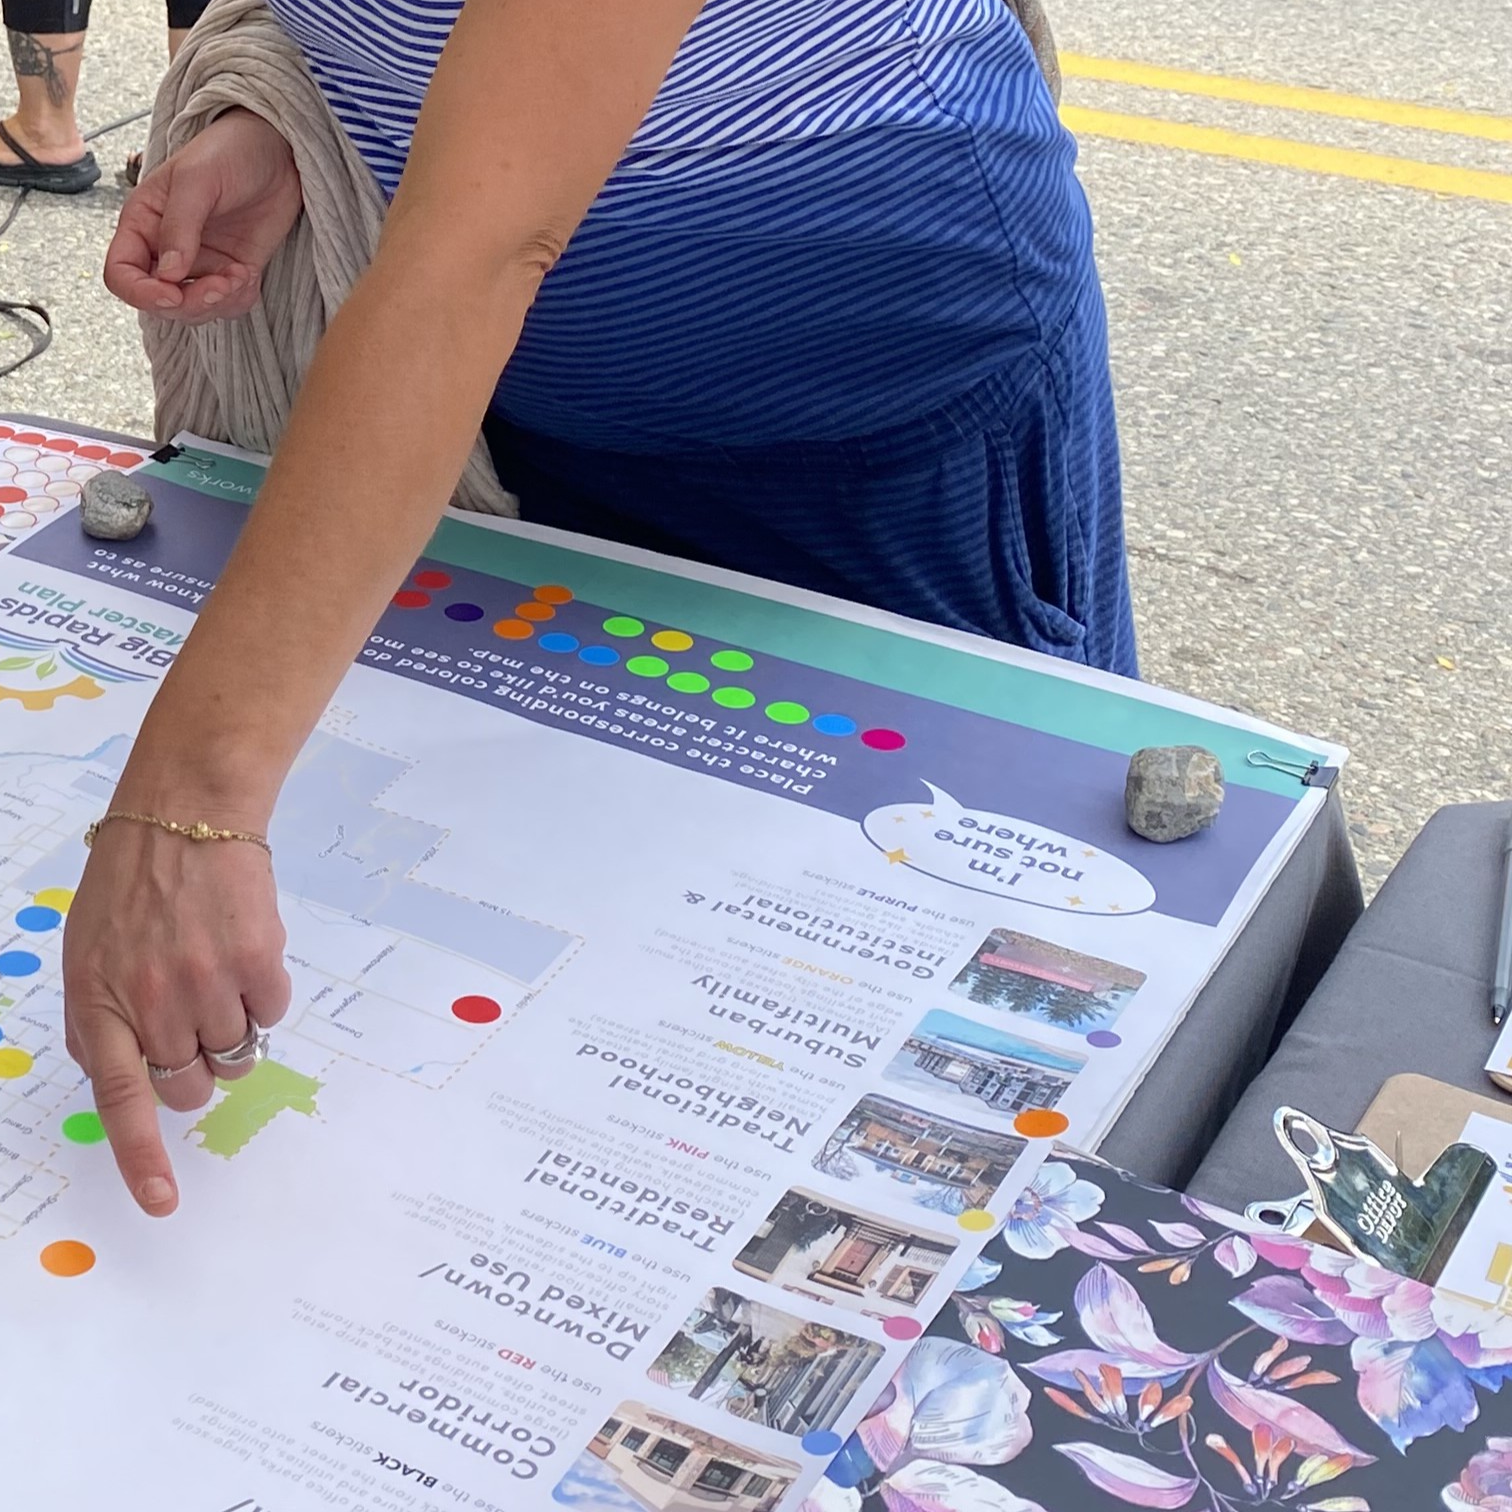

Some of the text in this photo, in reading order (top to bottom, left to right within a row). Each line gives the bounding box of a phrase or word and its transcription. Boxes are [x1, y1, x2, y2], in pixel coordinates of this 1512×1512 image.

[85, 560, 205, 604] know what
[93, 547, 117, 561] to
[120, 555, 146, 571] as
[15, 580, 88, 614] Plan
[116, 636, 177, 668] Big
[363, 648, 814, 795] Place the corresponding colored do
[369, 635, 828, 781] character areas you'd like to see mo
[467, 646, 839, 767] where it belongs on the map.
[933, 829, 1085, 882] not sure
[957, 816, 1068, 859] where
[967, 858, 1023, 887] I'm
[680, 889, 935, 980] Governmental &
[742, 893, 947, 967] Institutional
[801, 869, 975, 928] use the PURPLE stickers
[725, 936, 913, 1004] use the ORANGE stickers
[690, 973, 882, 1051] Multifamily
[708, 1004, 867, 1069] Suburban
[575, 1042, 813, 1137] Neighborhood
[657, 1019, 846, 1092] use the YELLOW stickers
[605, 1113, 772, 1182] use the PINK stickers
[607, 1074, 796, 1154] Traditional
[523, 1167, 716, 1253] Traditional
[536, 1149, 735, 1236] Residential
[1356, 1179, 1396, 1236] Office
[1376, 1192, 1407, 1244] DEPOT
[519, 1208, 691, 1284] use the BLUE stickers
[417, 1261, 636, 1362] Downtown/
[468, 1252, 651, 1343] Mixed Use
[434, 1319, 602, 1397] use the RED stickers
[308, 1419, 373, 1458] stickers
[321, 1371, 539, 1481] Commercial
[397, 1378, 557, 1458] Corridor
[371, 1451, 439, 1489] BLACK
